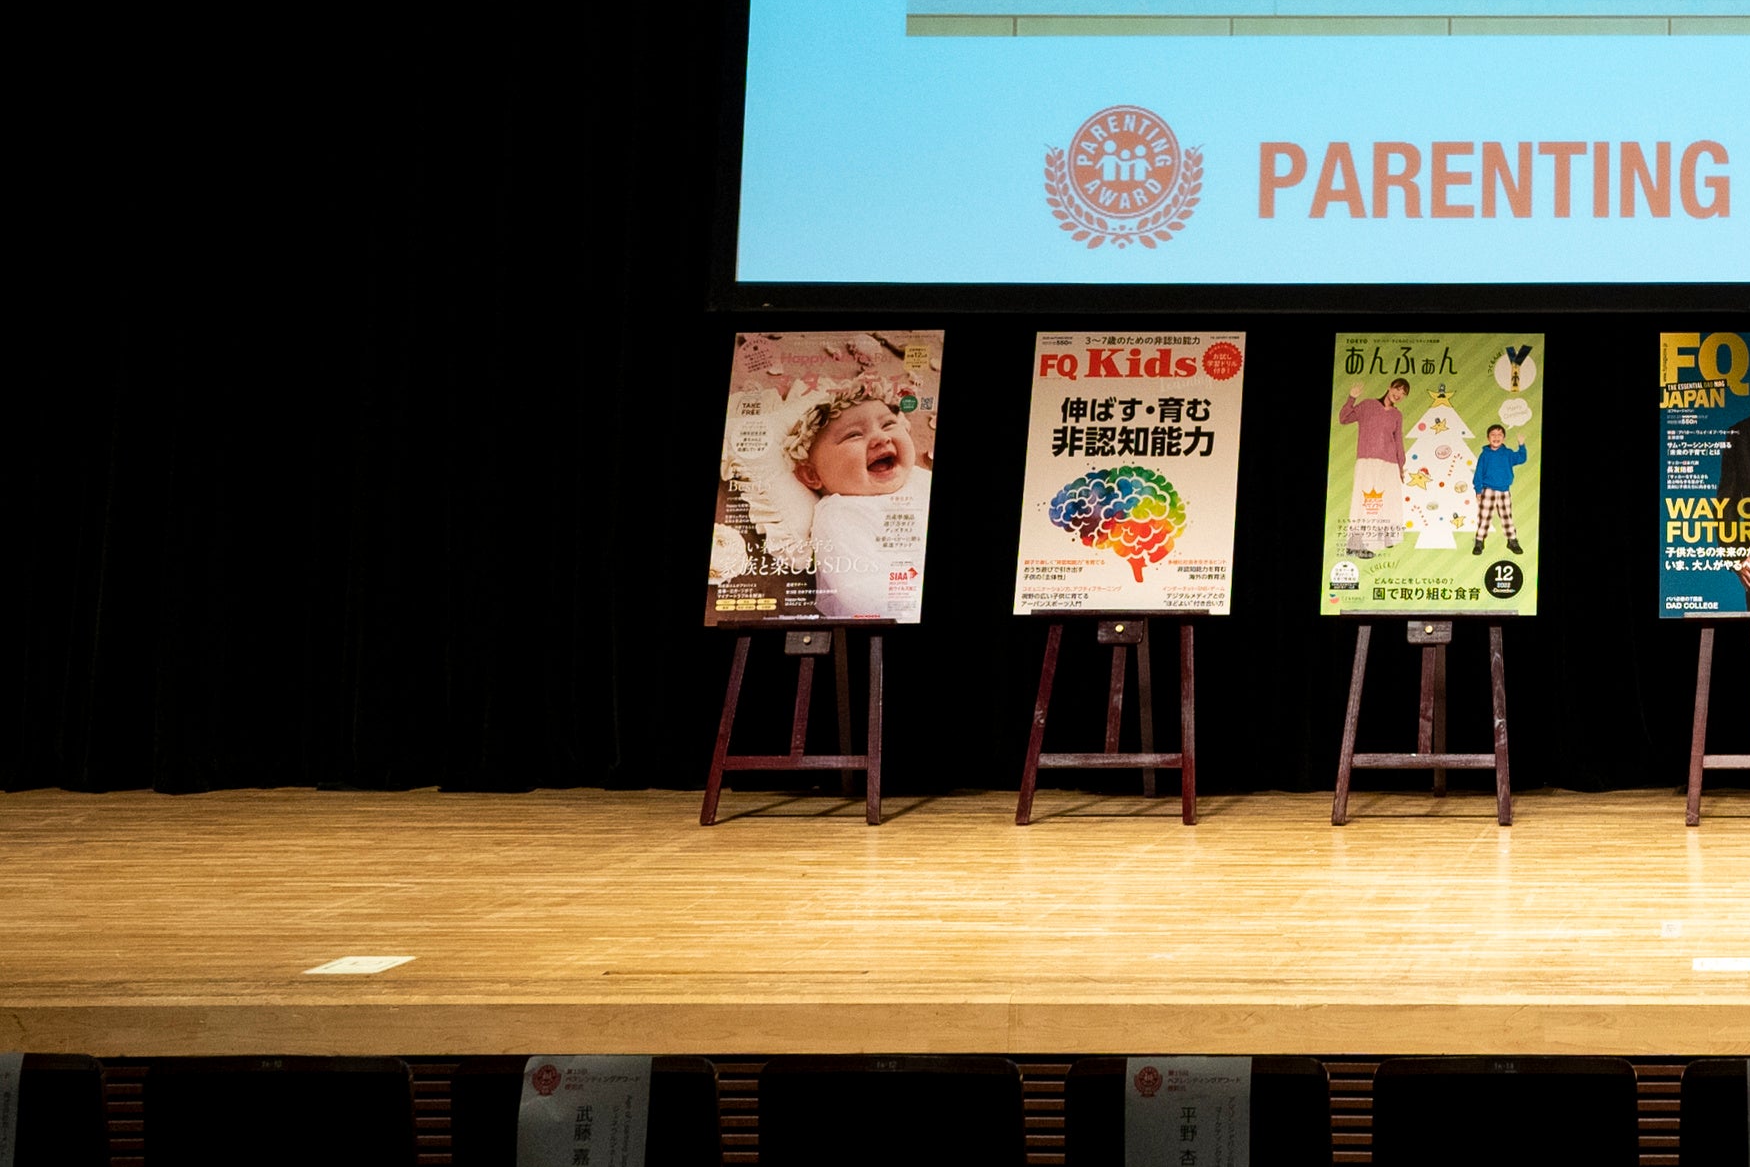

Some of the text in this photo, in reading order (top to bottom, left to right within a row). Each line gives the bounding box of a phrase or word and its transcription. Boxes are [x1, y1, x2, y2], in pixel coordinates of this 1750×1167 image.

[1076, 114, 1172, 167] PARENTING
[1084, 179, 1162, 210] AWARD
[1256, 141, 1730, 220] PARENTING
[1039, 348, 1199, 380] FQ Kids
[1345, 346, 1458, 375] あんふぁん
[1660, 332, 1750, 396] FQ
[1061, 396, 1212, 423] 伸ばす・育む
[1660, 387, 1725, 408] JAPAN
[1052, 426, 1215, 457] 非認知能力
[1665, 498, 1730, 519] WAY
[889, 570, 909, 581] SIAA
[1494, 565, 1514, 581] 12
[1372, 587, 1481, 602] 園で取り組む食育
